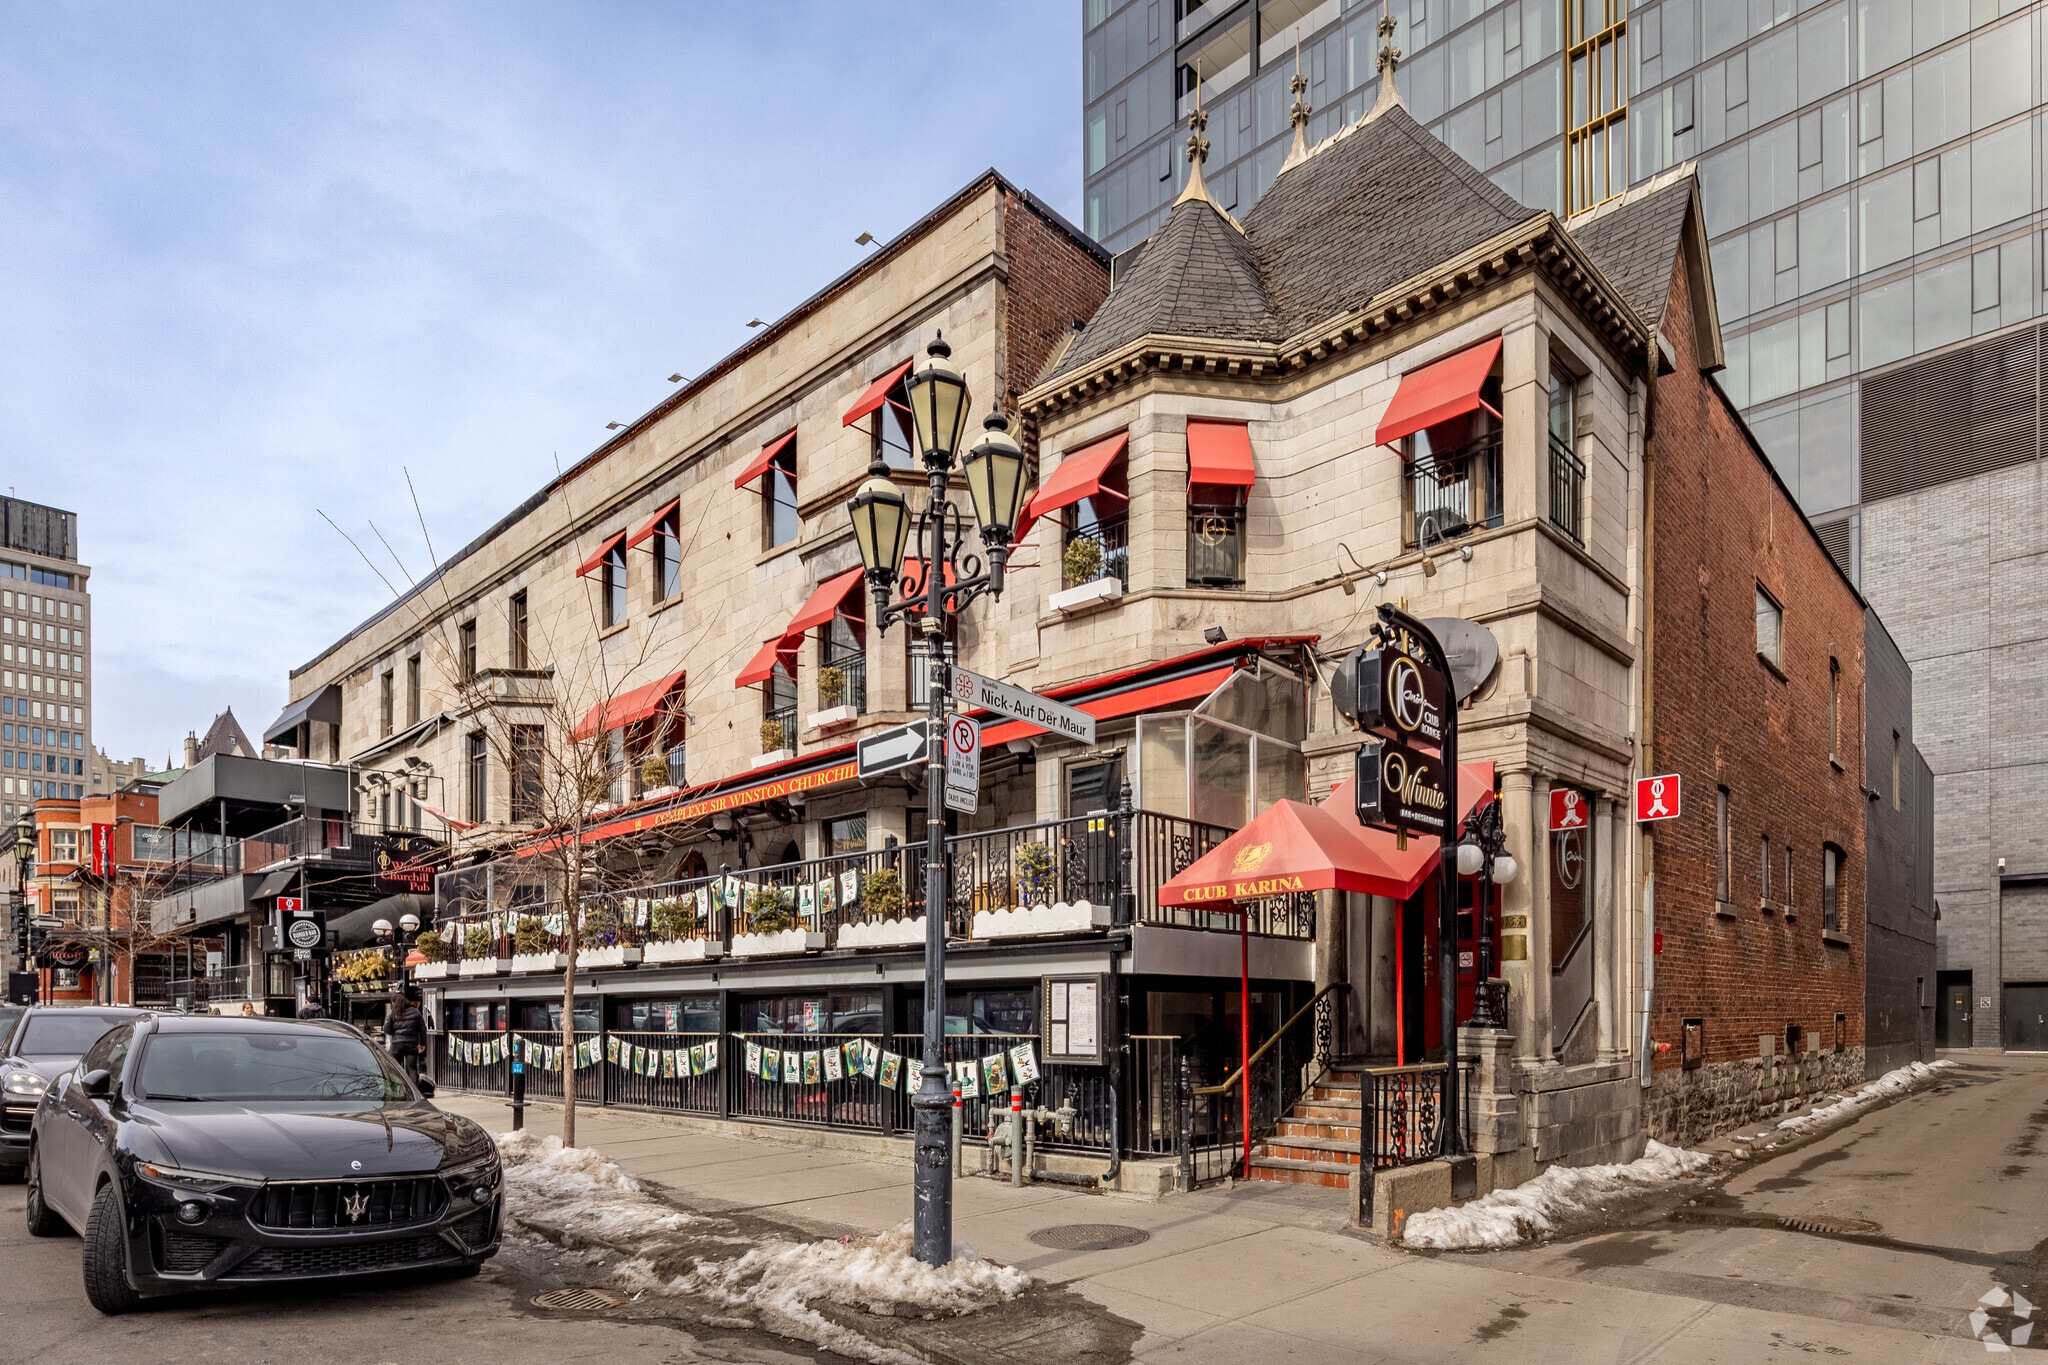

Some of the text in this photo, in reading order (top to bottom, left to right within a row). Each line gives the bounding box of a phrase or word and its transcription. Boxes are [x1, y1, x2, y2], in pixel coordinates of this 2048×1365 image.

[981, 679, 998, 690] Ruelle
[981, 687, 1087, 737] Nick-Auf Der Maur
[1424, 712, 1440, 728] CLUB
[1421, 723, 1441, 740] LOUNGE
[1384, 752, 1445, 810] Winnie
[654, 803, 708, 826] COMPLEXE
[710, 798, 727, 812] SIR
[729, 782, 786, 806] WINSTON
[948, 793, 974, 807] TAXIS INCLUS
[391, 861, 435, 873] Winston
[381, 870, 430, 882] Churchill
[410, 881, 430, 892] Pub
[1183, 885, 1228, 901] CLUB
[1234, 876, 1304, 896] KARINA
